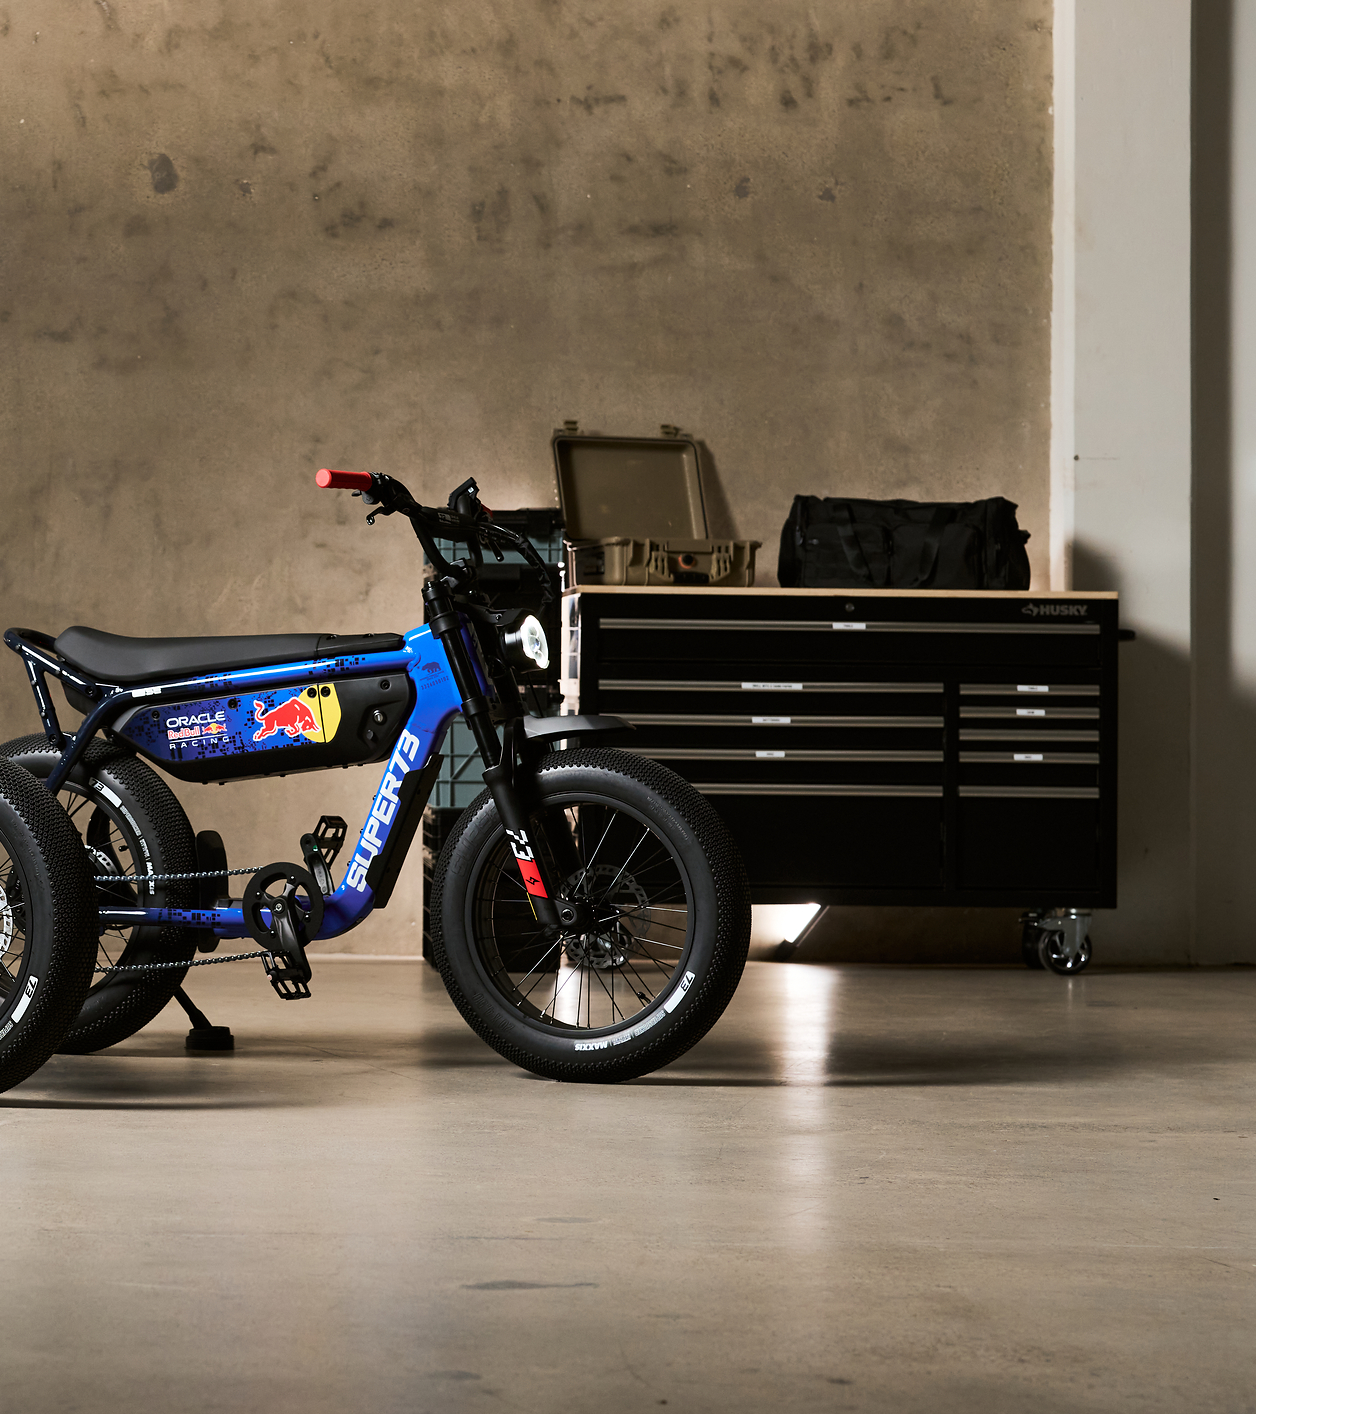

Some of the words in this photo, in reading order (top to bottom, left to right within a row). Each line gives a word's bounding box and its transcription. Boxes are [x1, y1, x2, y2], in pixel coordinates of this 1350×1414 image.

[1039, 604, 1088, 616] HUSKY
[166, 710, 226, 728] ORACLE
[169, 736, 230, 750] RACING
[346, 728, 420, 893] SUPER73
[25, 980, 37, 999] 73
[680, 975, 694, 993] 73
[574, 1040, 608, 1052] MAXXIS
